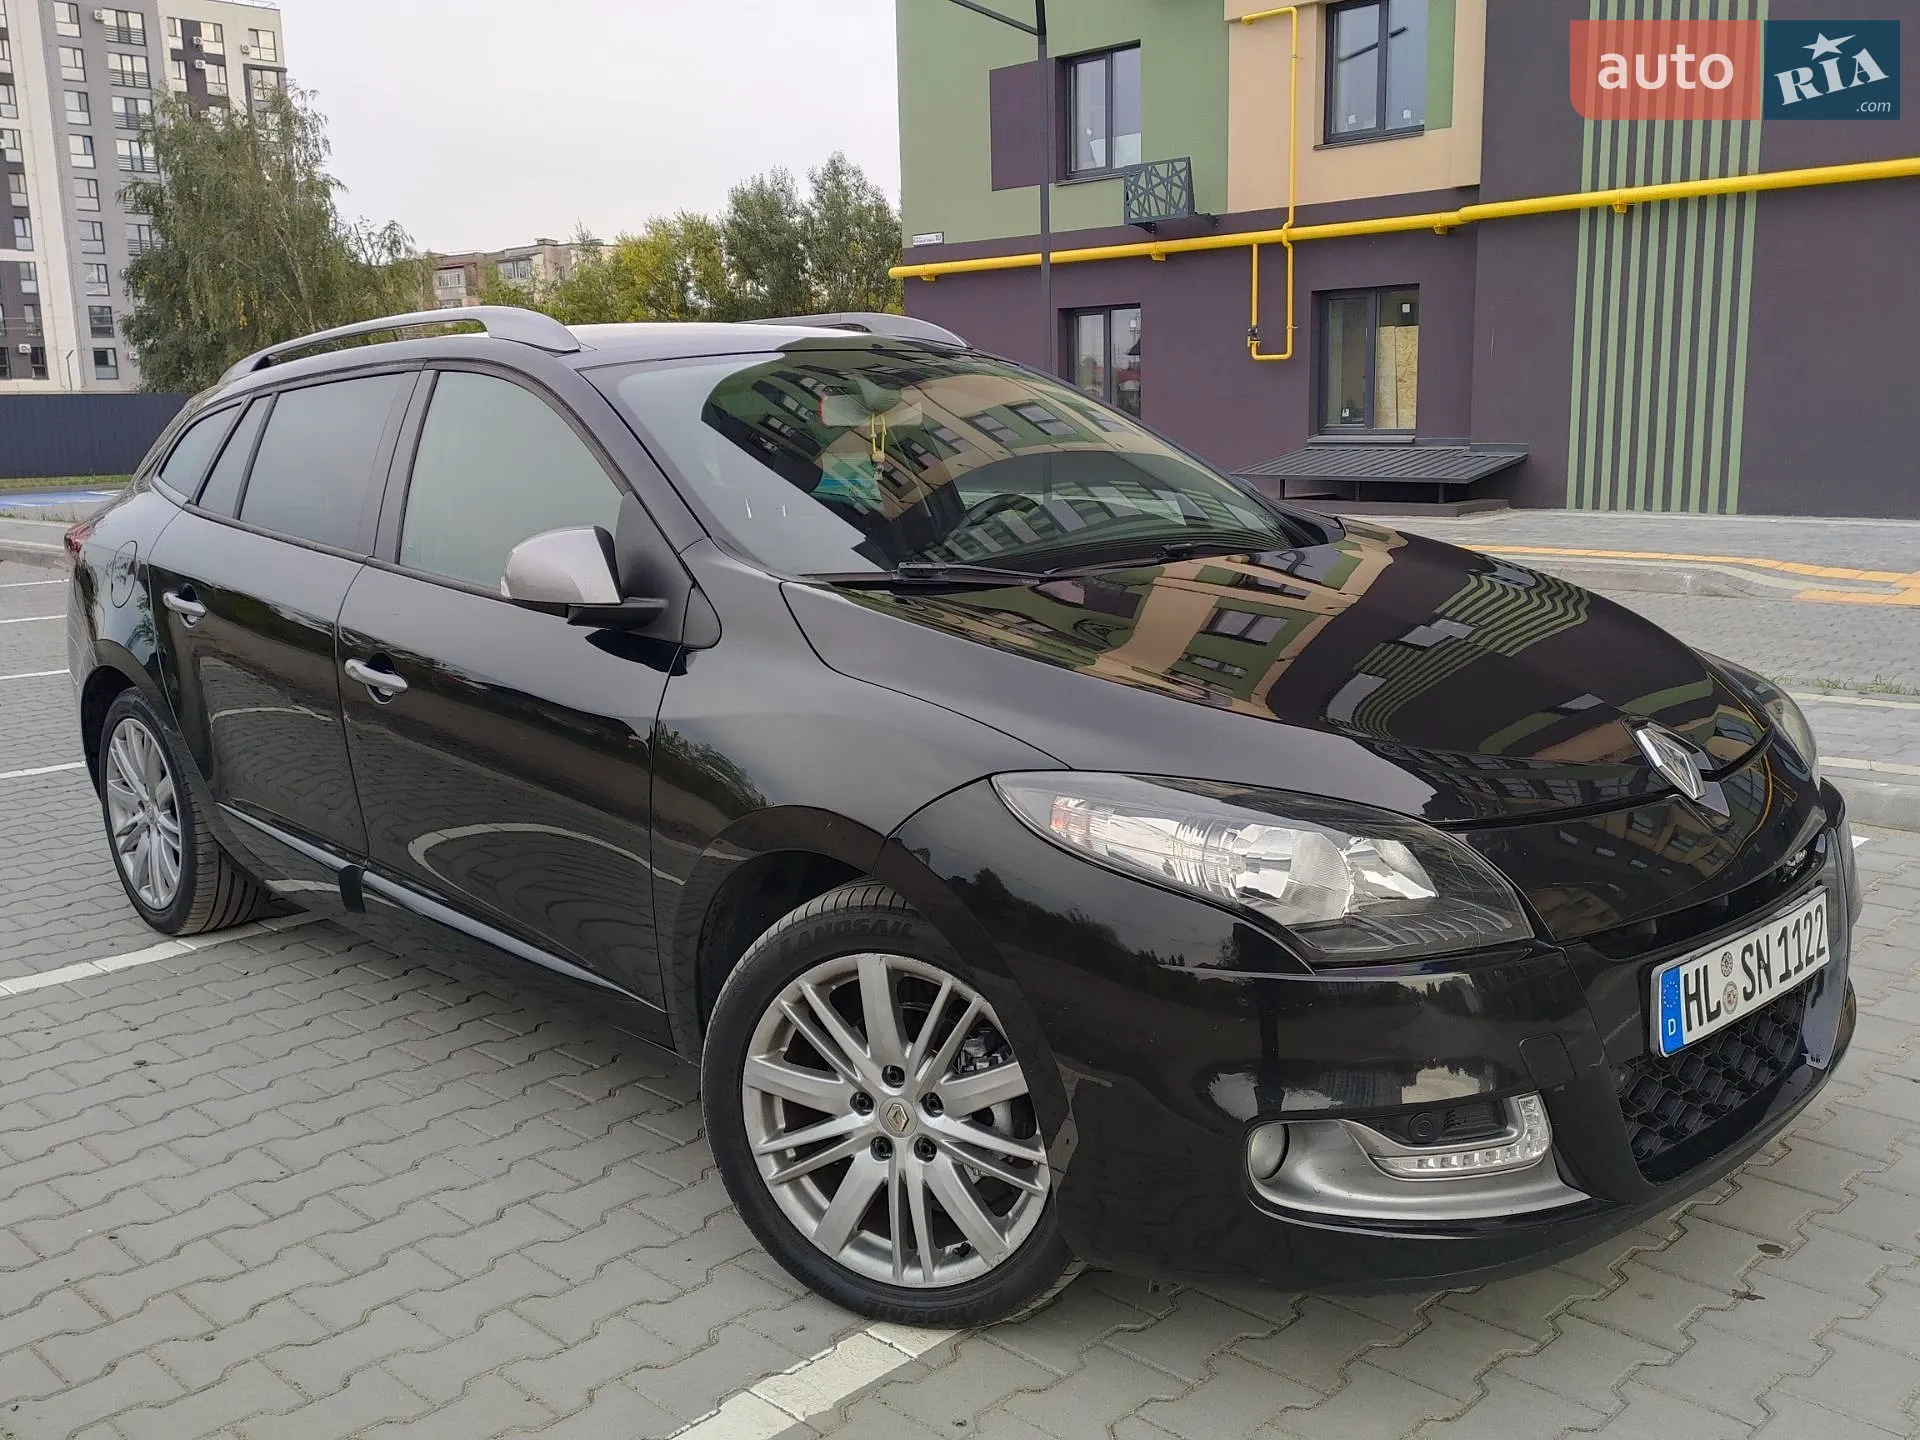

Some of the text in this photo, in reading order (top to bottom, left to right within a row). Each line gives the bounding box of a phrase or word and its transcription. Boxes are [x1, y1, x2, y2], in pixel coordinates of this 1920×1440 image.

[1683, 904, 1826, 1033] HL SN 1122
[1667, 1018, 1677, 1036] D
